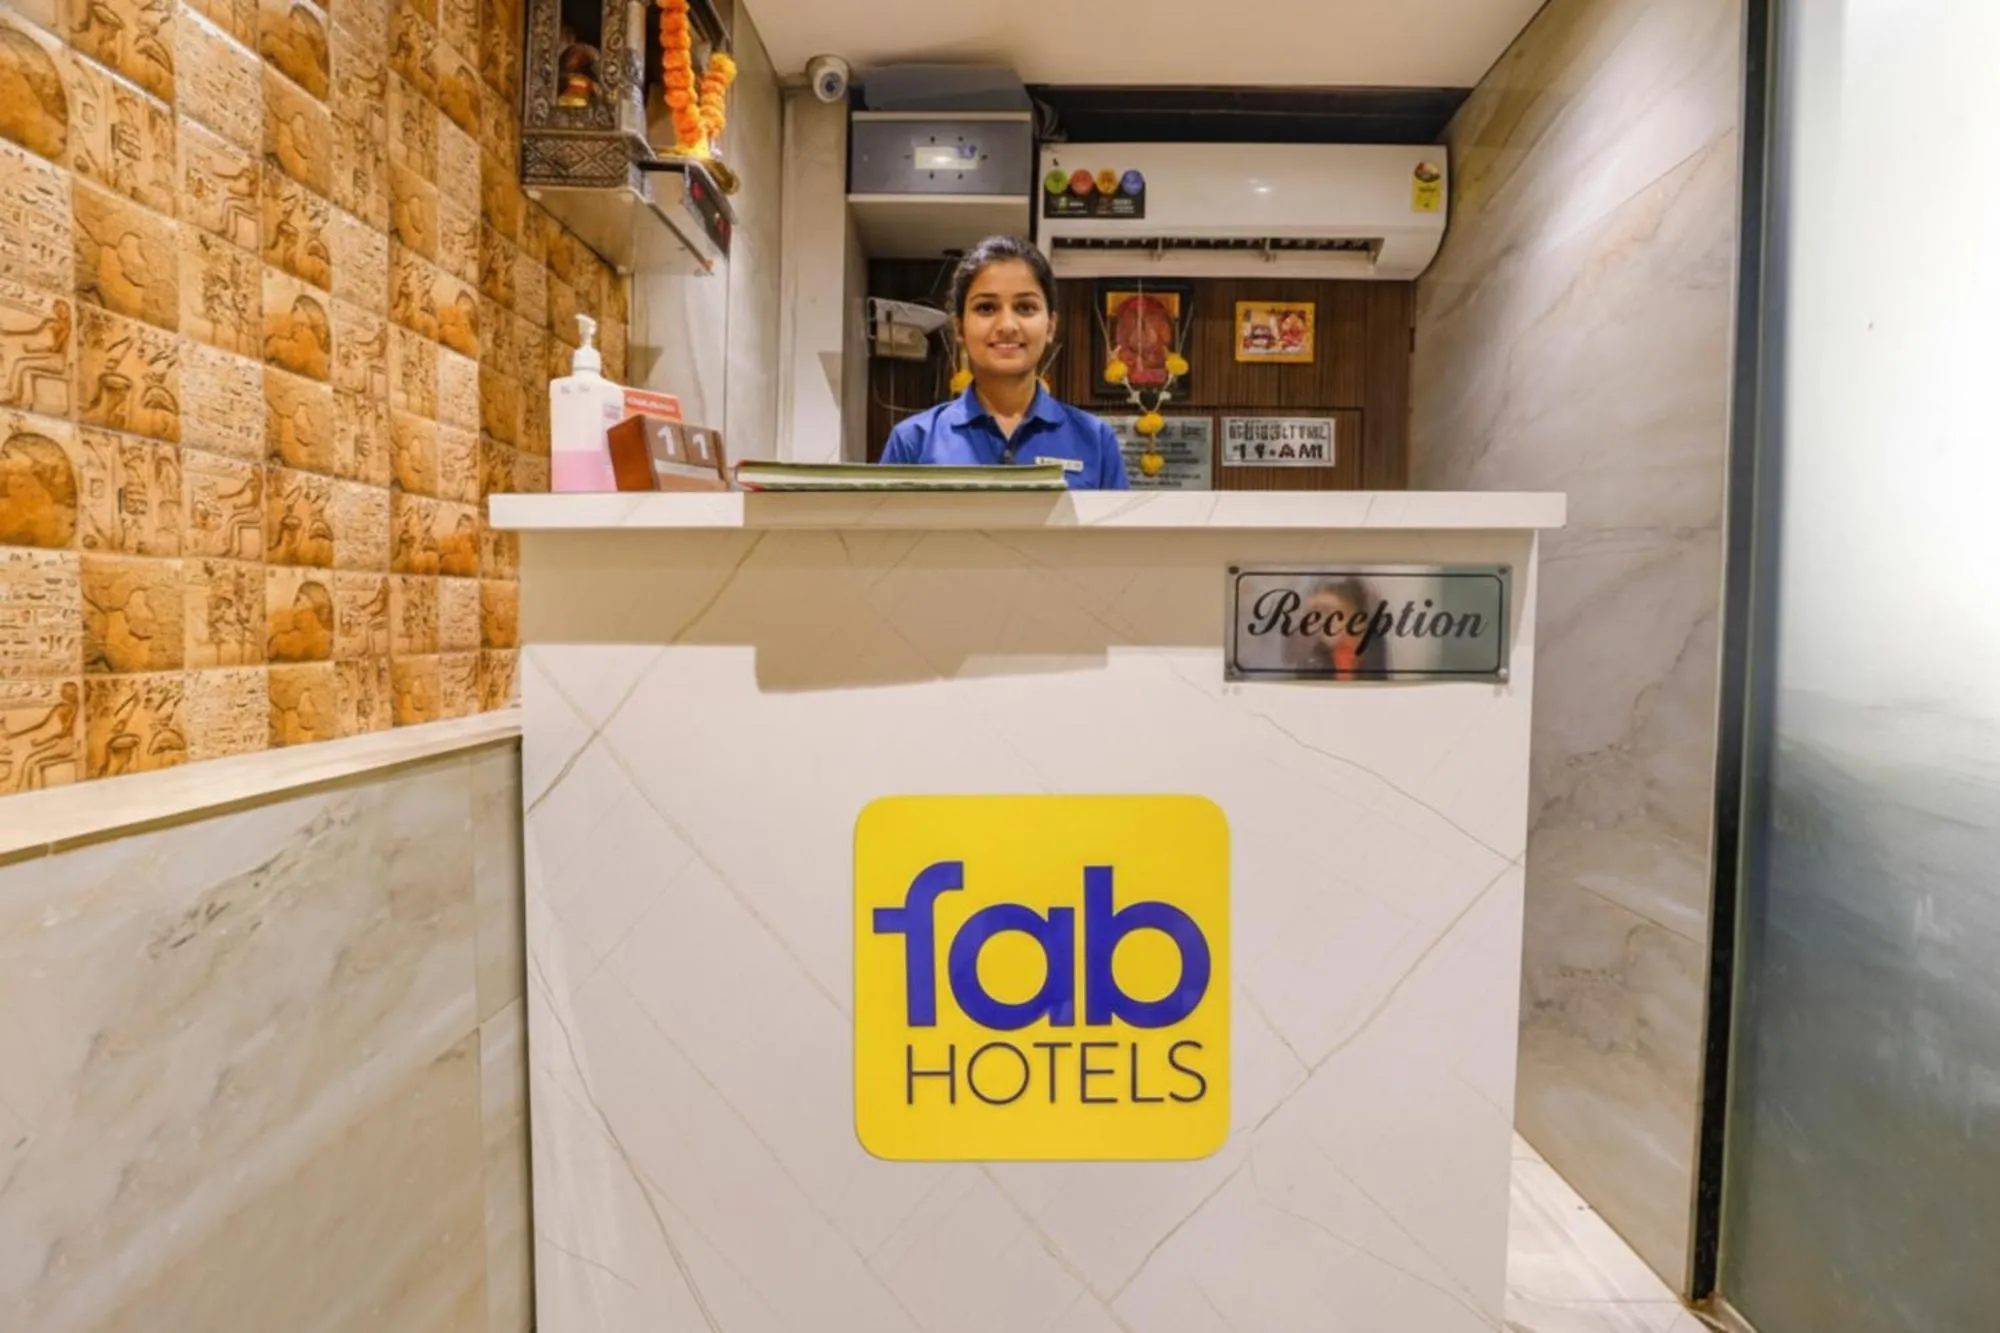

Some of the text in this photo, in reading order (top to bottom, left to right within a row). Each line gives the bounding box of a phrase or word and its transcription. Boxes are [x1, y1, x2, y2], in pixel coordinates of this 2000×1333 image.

[1248, 589, 1486, 656] Reception
[873, 861, 1211, 1030] fab
[907, 1040, 1206, 1105] HOTELS
